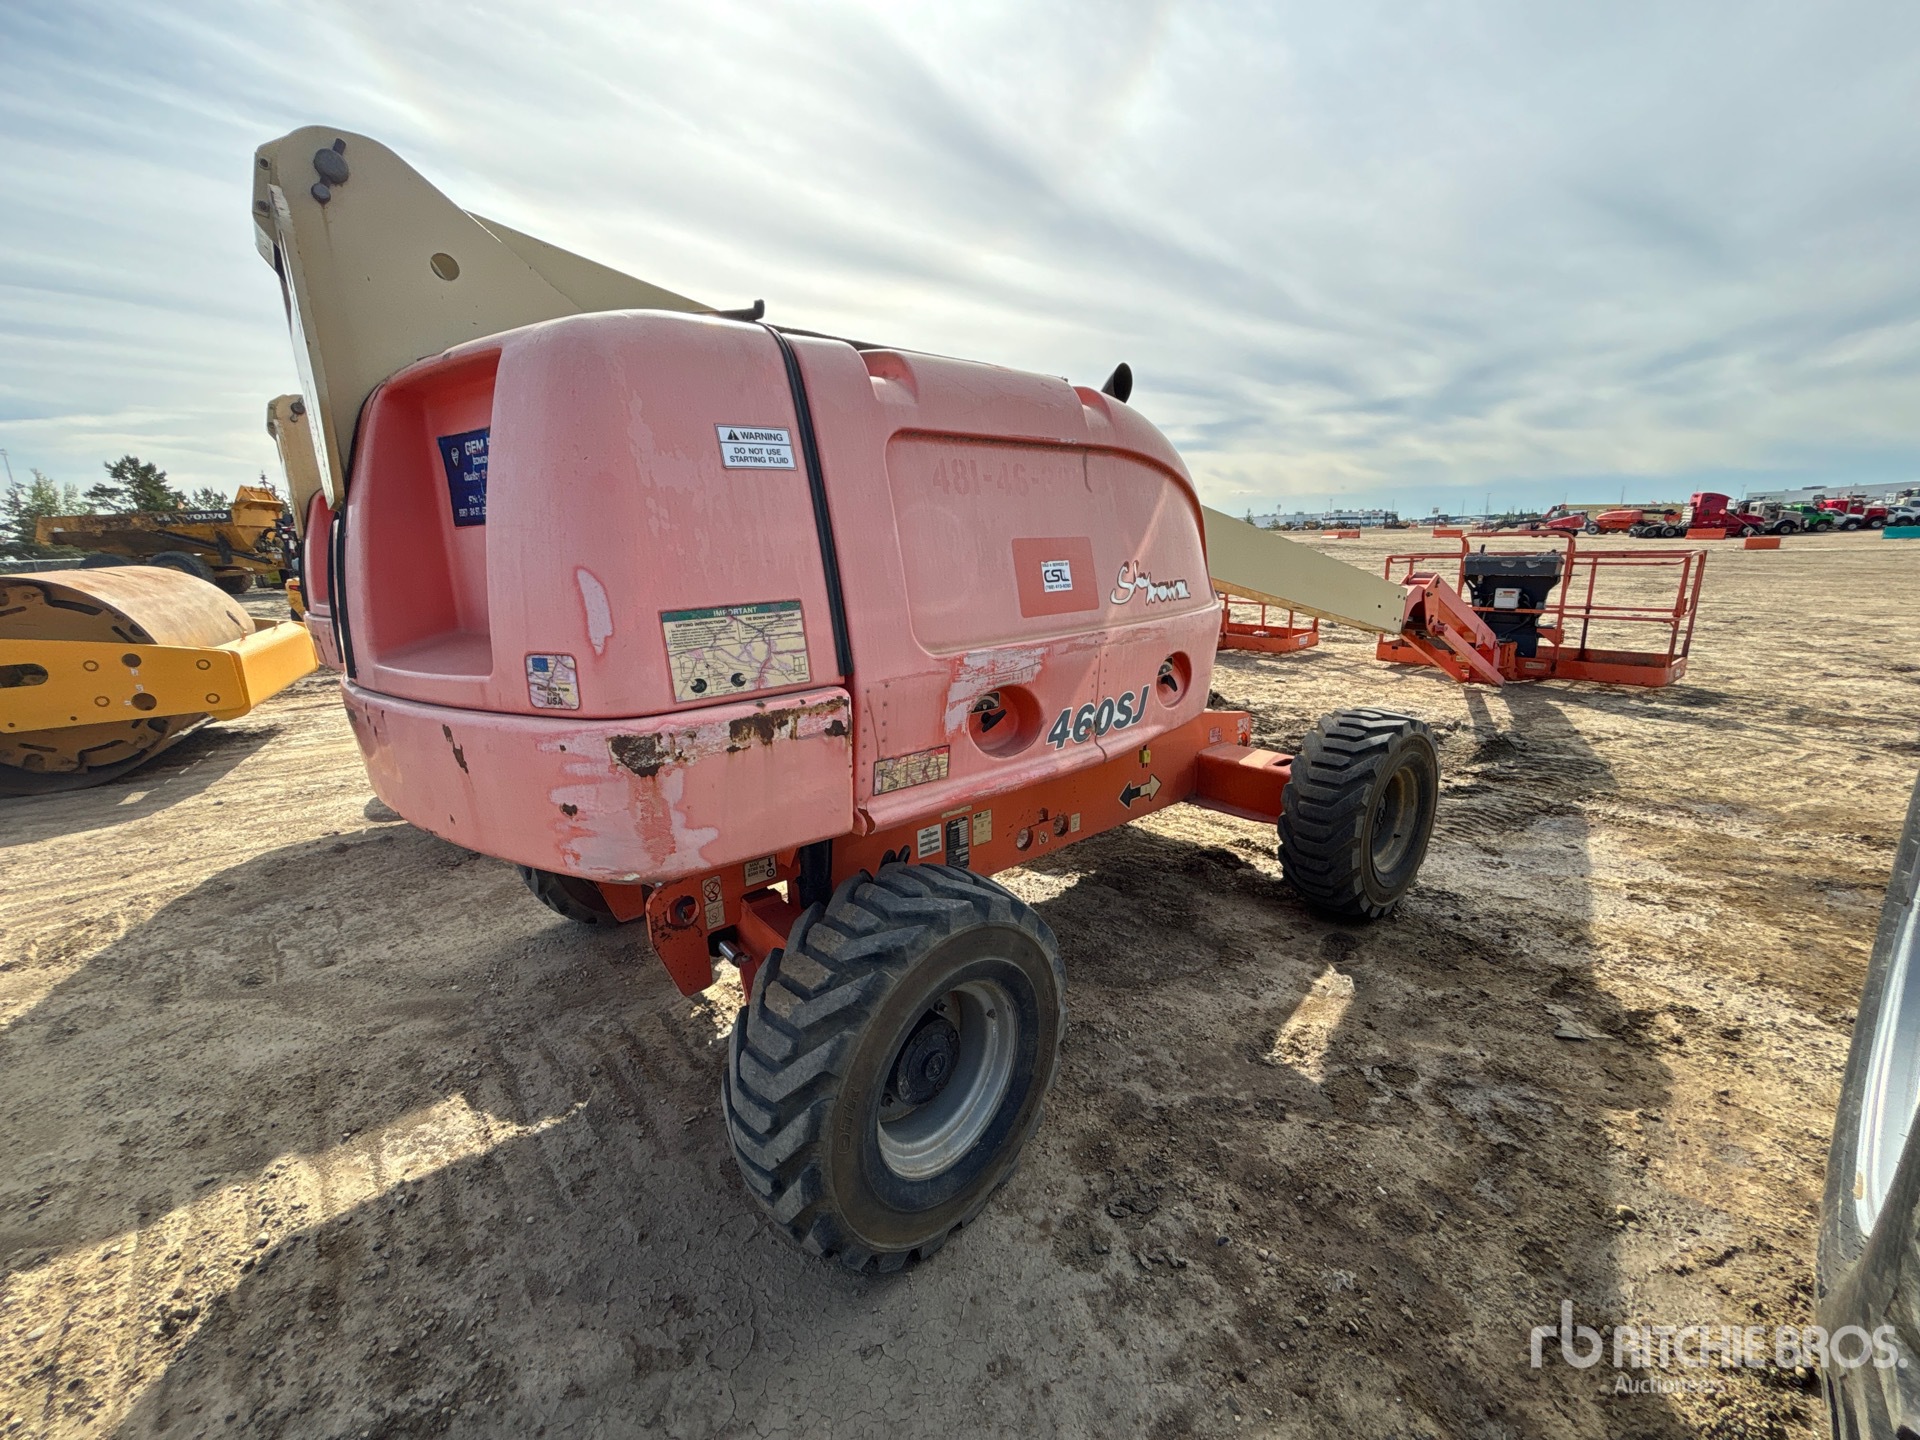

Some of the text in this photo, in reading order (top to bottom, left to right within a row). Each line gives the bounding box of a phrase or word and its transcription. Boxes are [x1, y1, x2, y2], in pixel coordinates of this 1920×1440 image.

[740, 431, 783, 441] WARNING
[464, 439, 484, 455] GEM
[733, 447, 746, 455] DO
[730, 455, 766, 463] STARTING
[185, 513, 227, 521] VOLVO
[1044, 569, 1070, 583] CSL
[713, 606, 757, 617] IMPORTANT
[547, 697, 563, 706] USA
[1046, 684, 1151, 750] 460SJ
